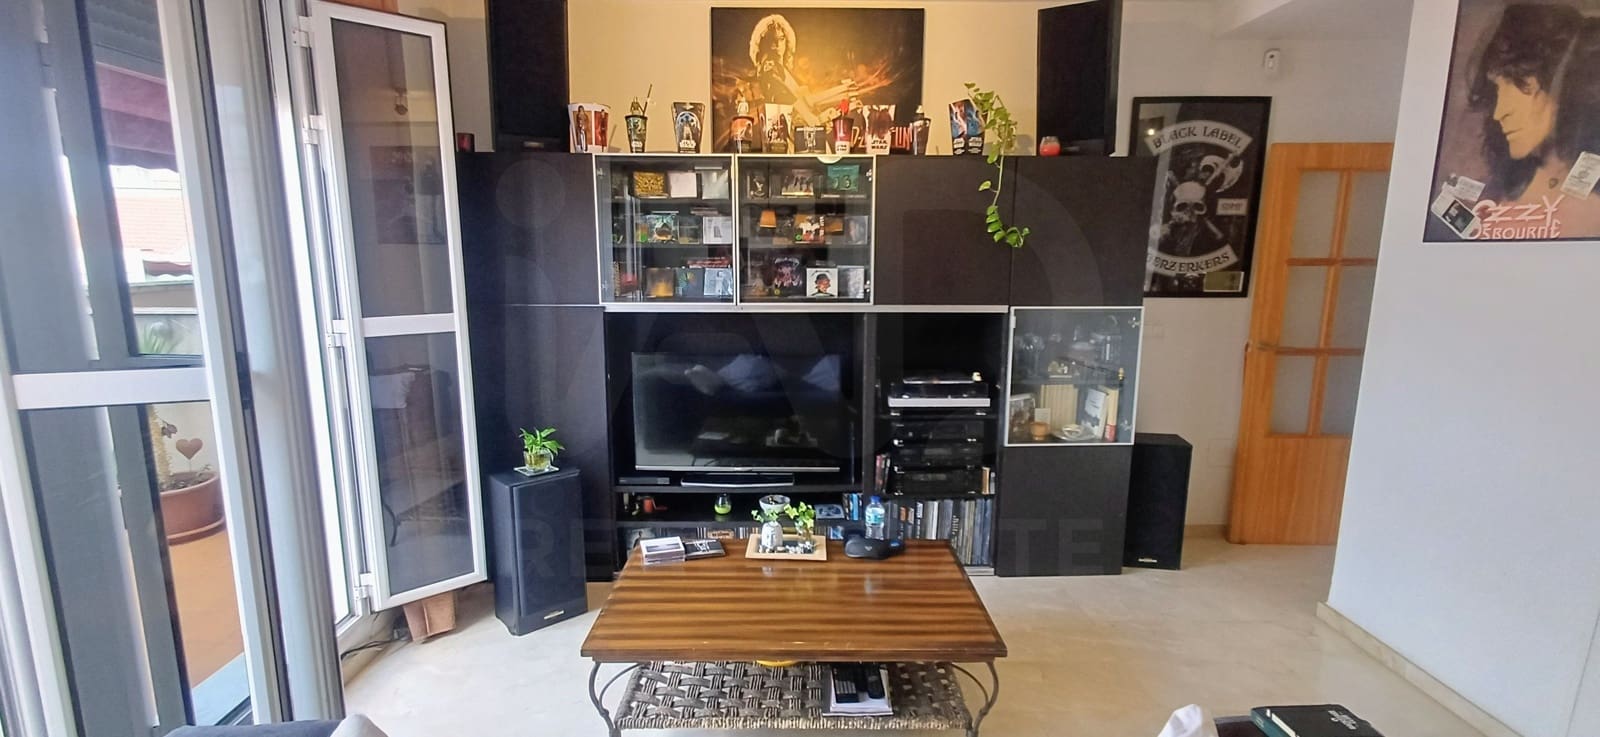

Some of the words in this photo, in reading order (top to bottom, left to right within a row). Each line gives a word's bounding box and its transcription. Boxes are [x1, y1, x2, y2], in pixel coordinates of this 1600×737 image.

[1152, 126, 1197, 149] BLACK
[1202, 126, 1242, 149] LABEL
[1472, 194, 1566, 228] OZZY
